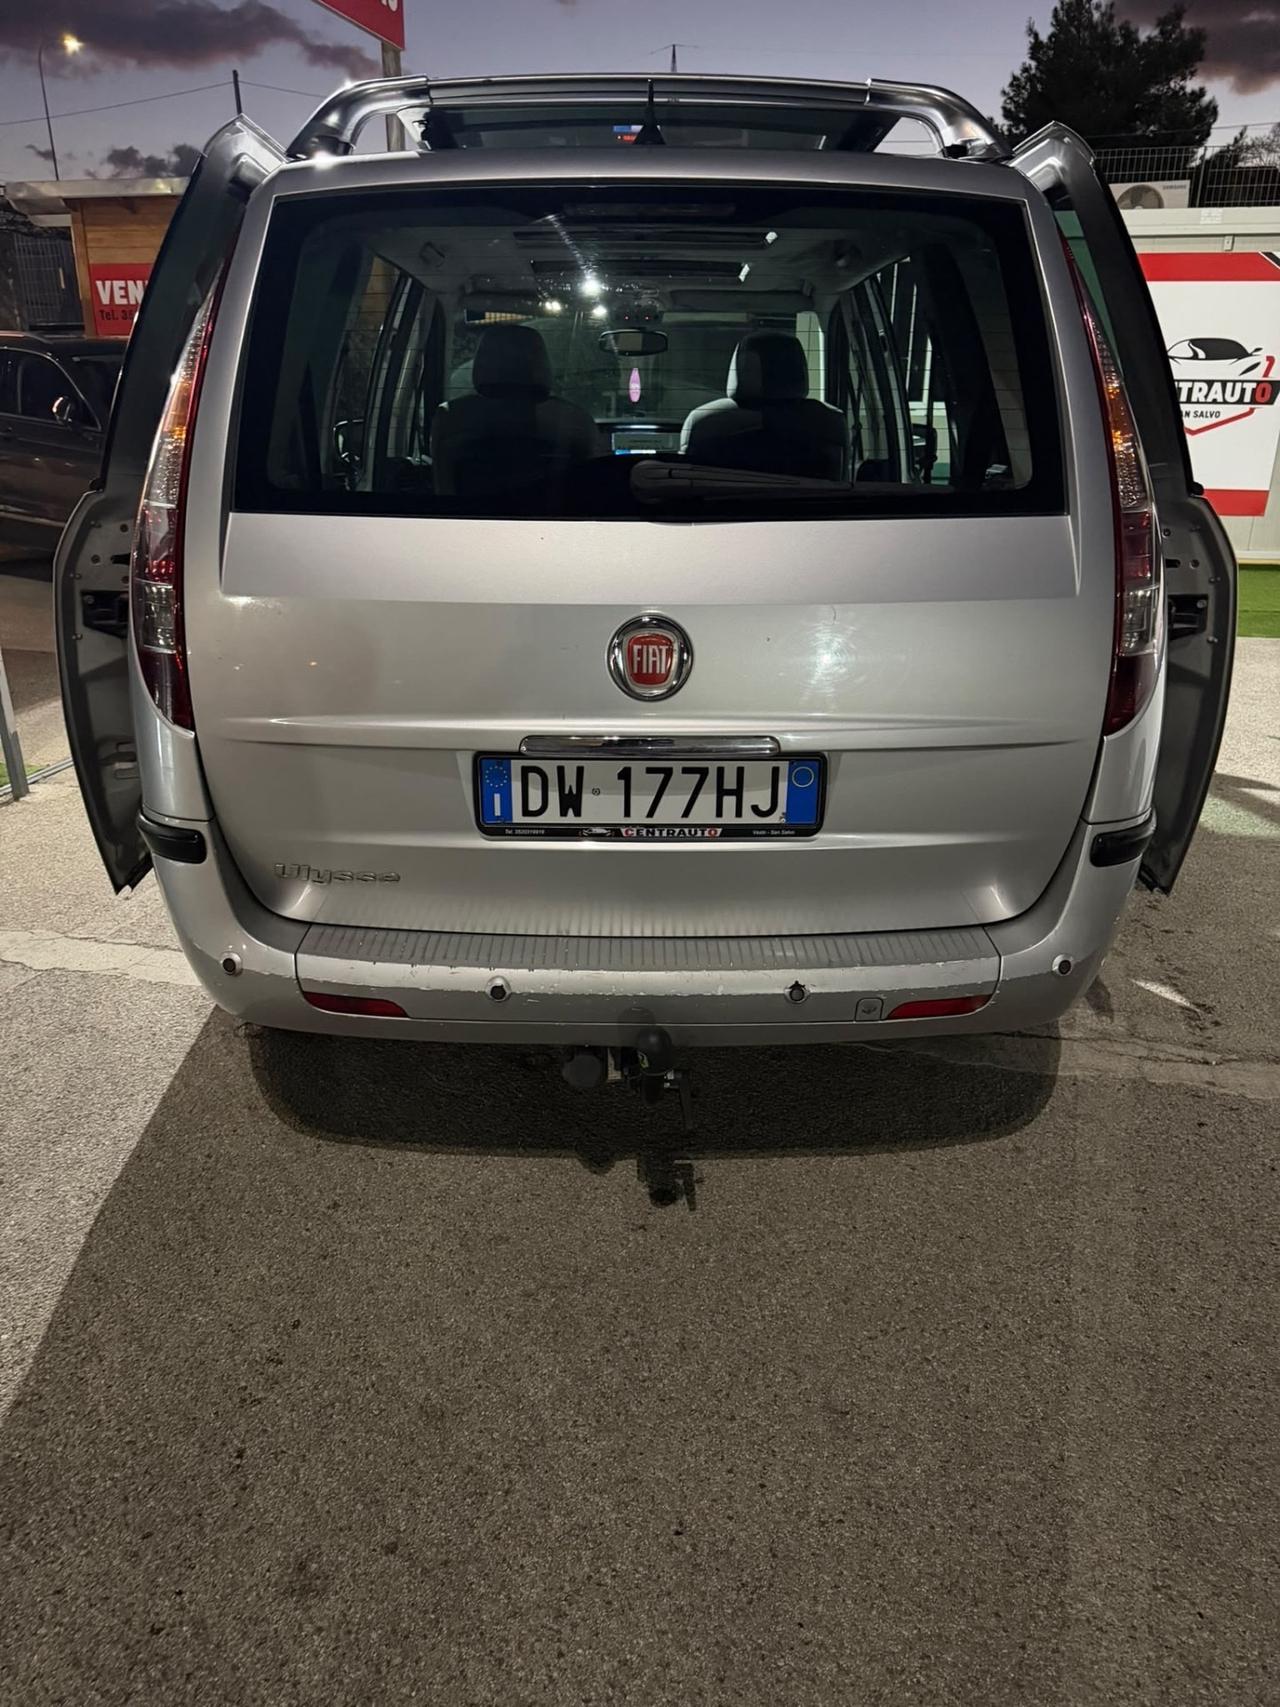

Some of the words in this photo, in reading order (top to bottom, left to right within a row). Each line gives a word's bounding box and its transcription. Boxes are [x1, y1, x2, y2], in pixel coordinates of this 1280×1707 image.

[95, 280, 149, 305] VEN
[1175, 381, 1272, 403] TRAUTO
[1193, 410, 1221, 419] SALVO
[632, 644, 669, 674] FIAT
[521, 765, 584, 817] DW
[617, 766, 780, 818] 177HJ
[624, 828, 718, 837] CENTRAUTO
[273, 862, 401, 886] Ulysse
